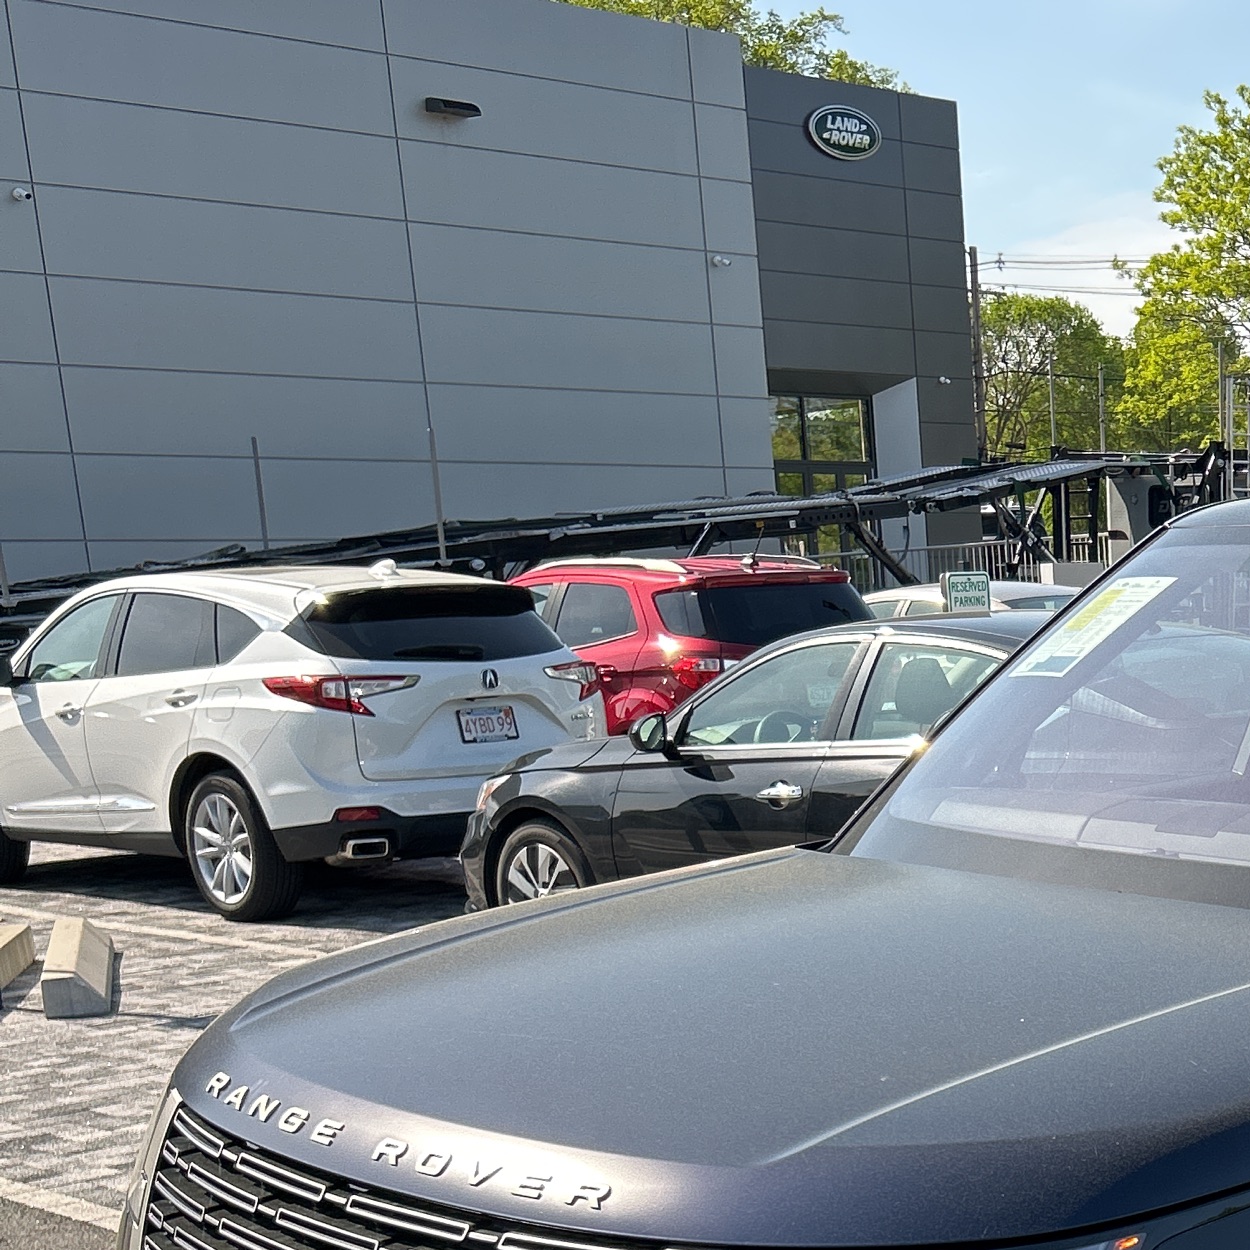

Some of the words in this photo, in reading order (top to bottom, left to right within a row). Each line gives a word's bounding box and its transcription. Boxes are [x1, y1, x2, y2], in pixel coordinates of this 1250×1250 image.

[826, 115, 860, 132] LAND
[830, 130, 871, 149] ROVER
[951, 581, 986, 593] RESERVED
[954, 595, 986, 607] PARKING
[497, 715, 513, 732] 99
[205, 1071, 345, 1146] RANGE
[371, 1137, 612, 1210] ROVER
